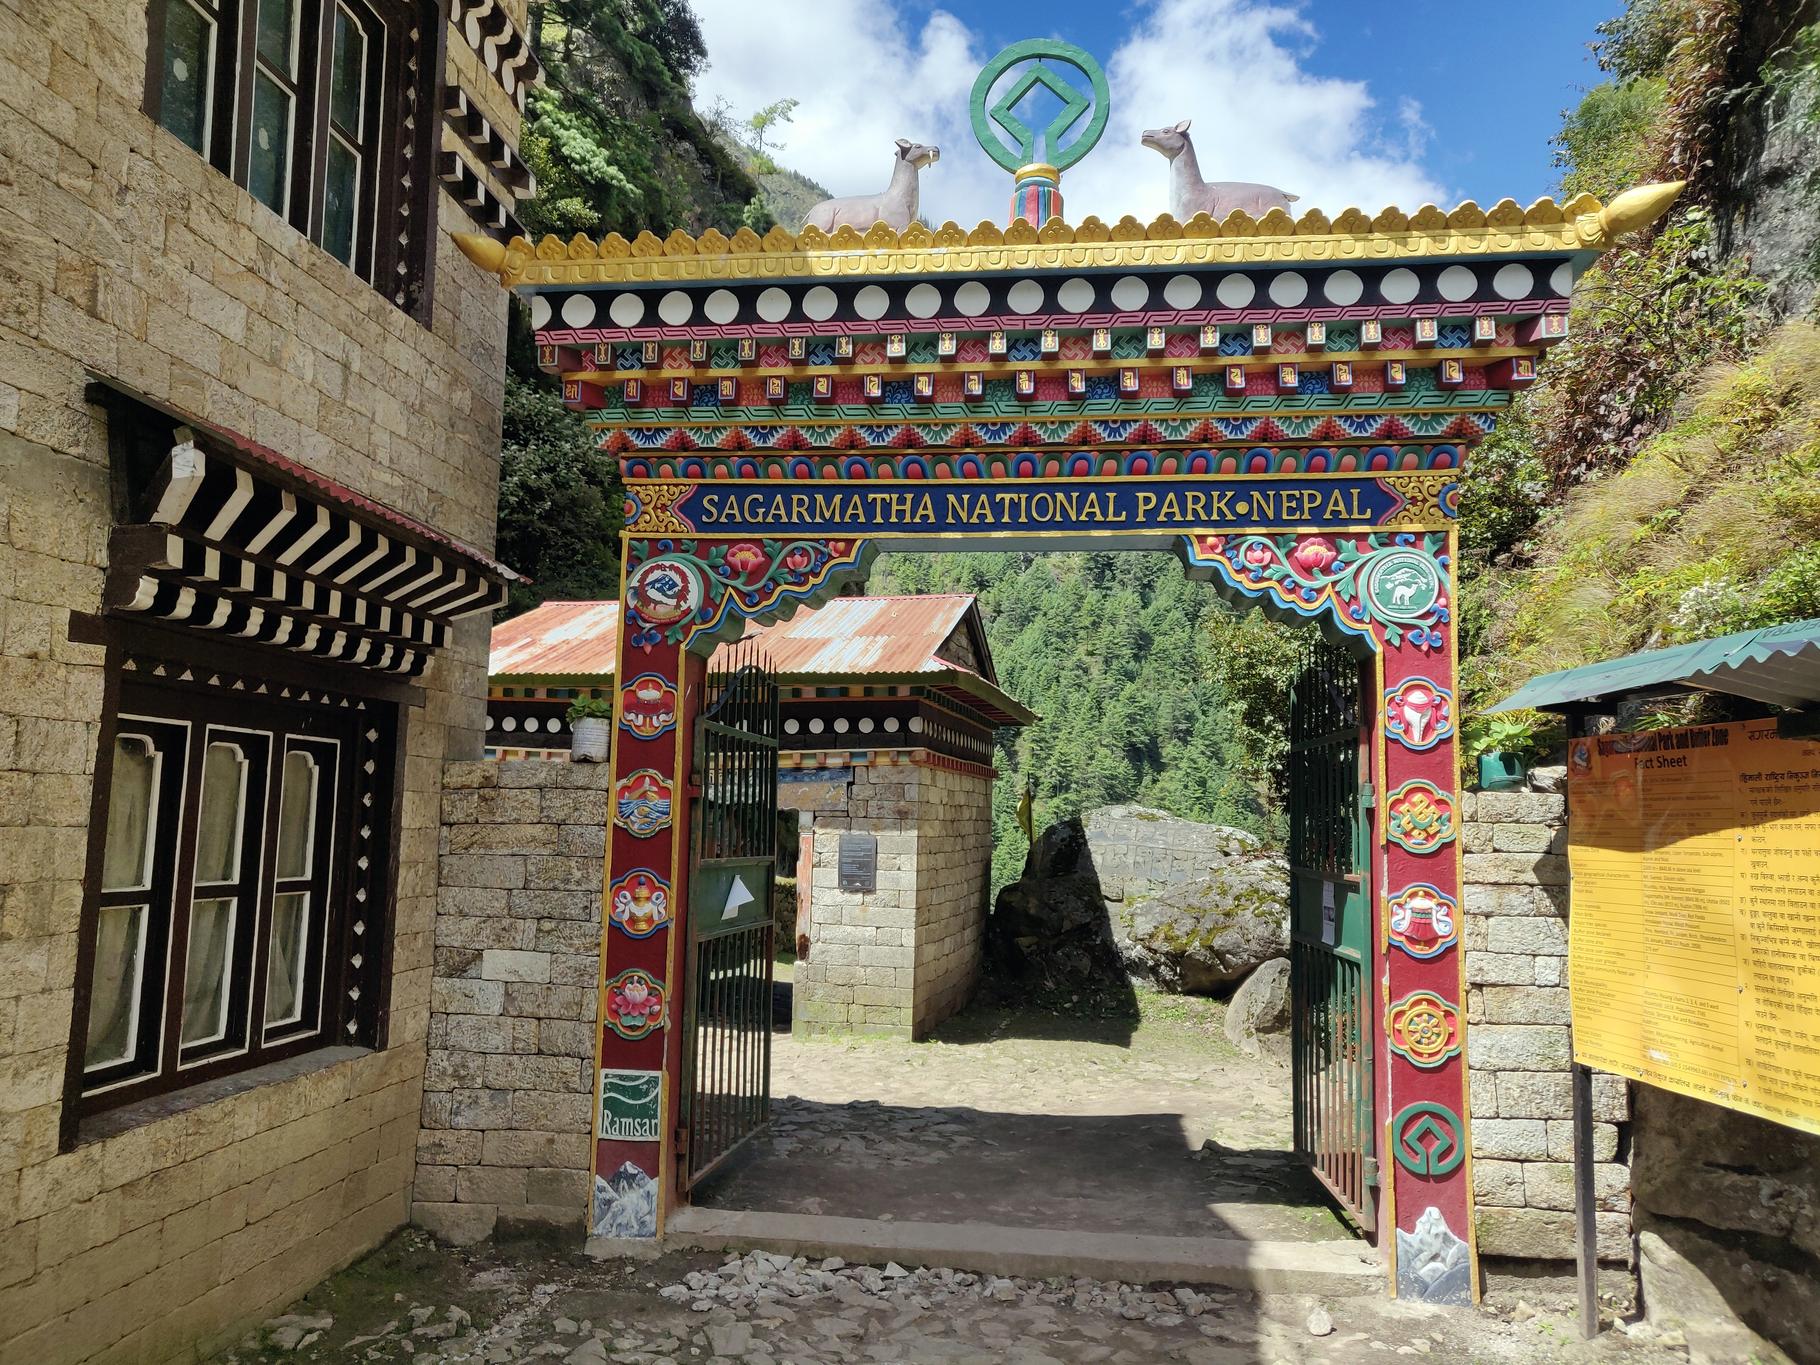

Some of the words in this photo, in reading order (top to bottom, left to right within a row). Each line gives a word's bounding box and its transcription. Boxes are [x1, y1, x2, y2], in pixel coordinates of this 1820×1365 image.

[701, 491, 935, 523] SAGARMATHA
[945, 491, 1126, 523] NATIONAL
[1657, 754, 1688, 768] Sheet
[602, 1109, 659, 1137] Ramsar
